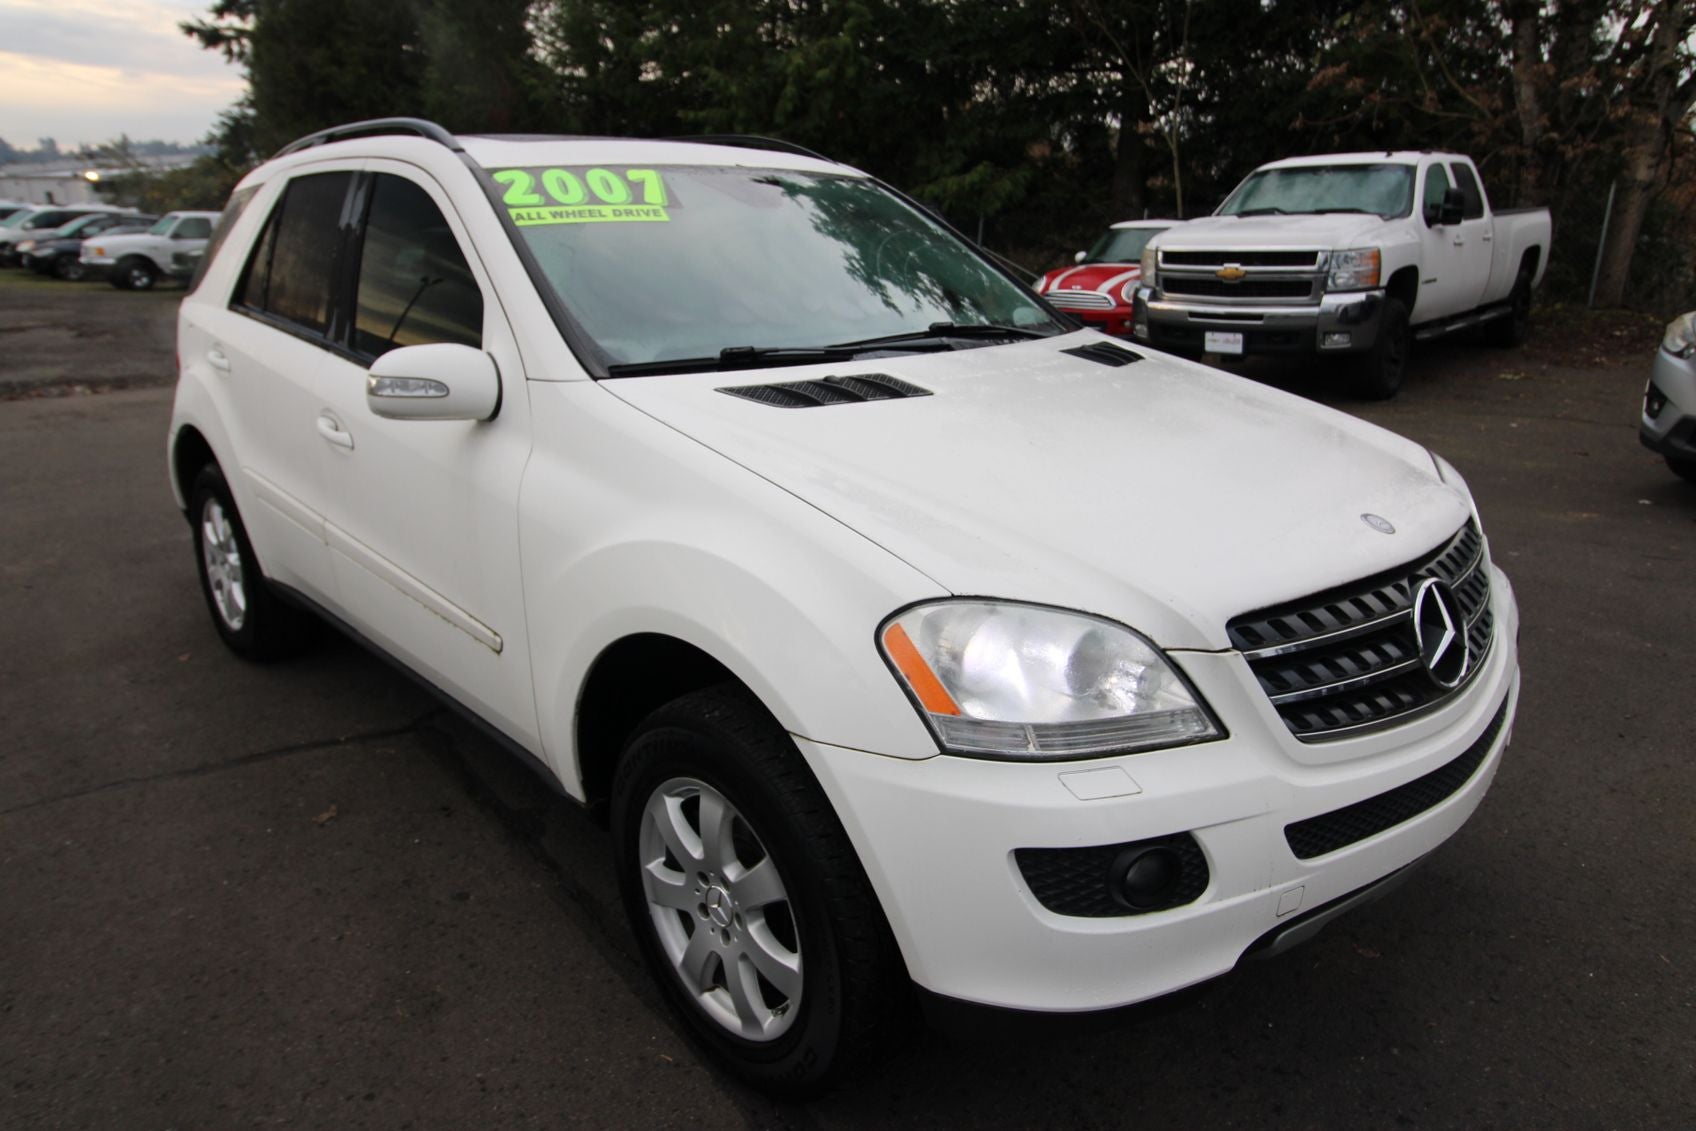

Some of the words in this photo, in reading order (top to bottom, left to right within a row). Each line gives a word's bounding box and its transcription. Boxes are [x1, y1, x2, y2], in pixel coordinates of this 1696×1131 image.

[492, 168, 668, 206] 2007
[514, 210, 546, 222] ALL
[549, 208, 607, 220] WHEEL
[612, 208, 663, 218] DRIVE
